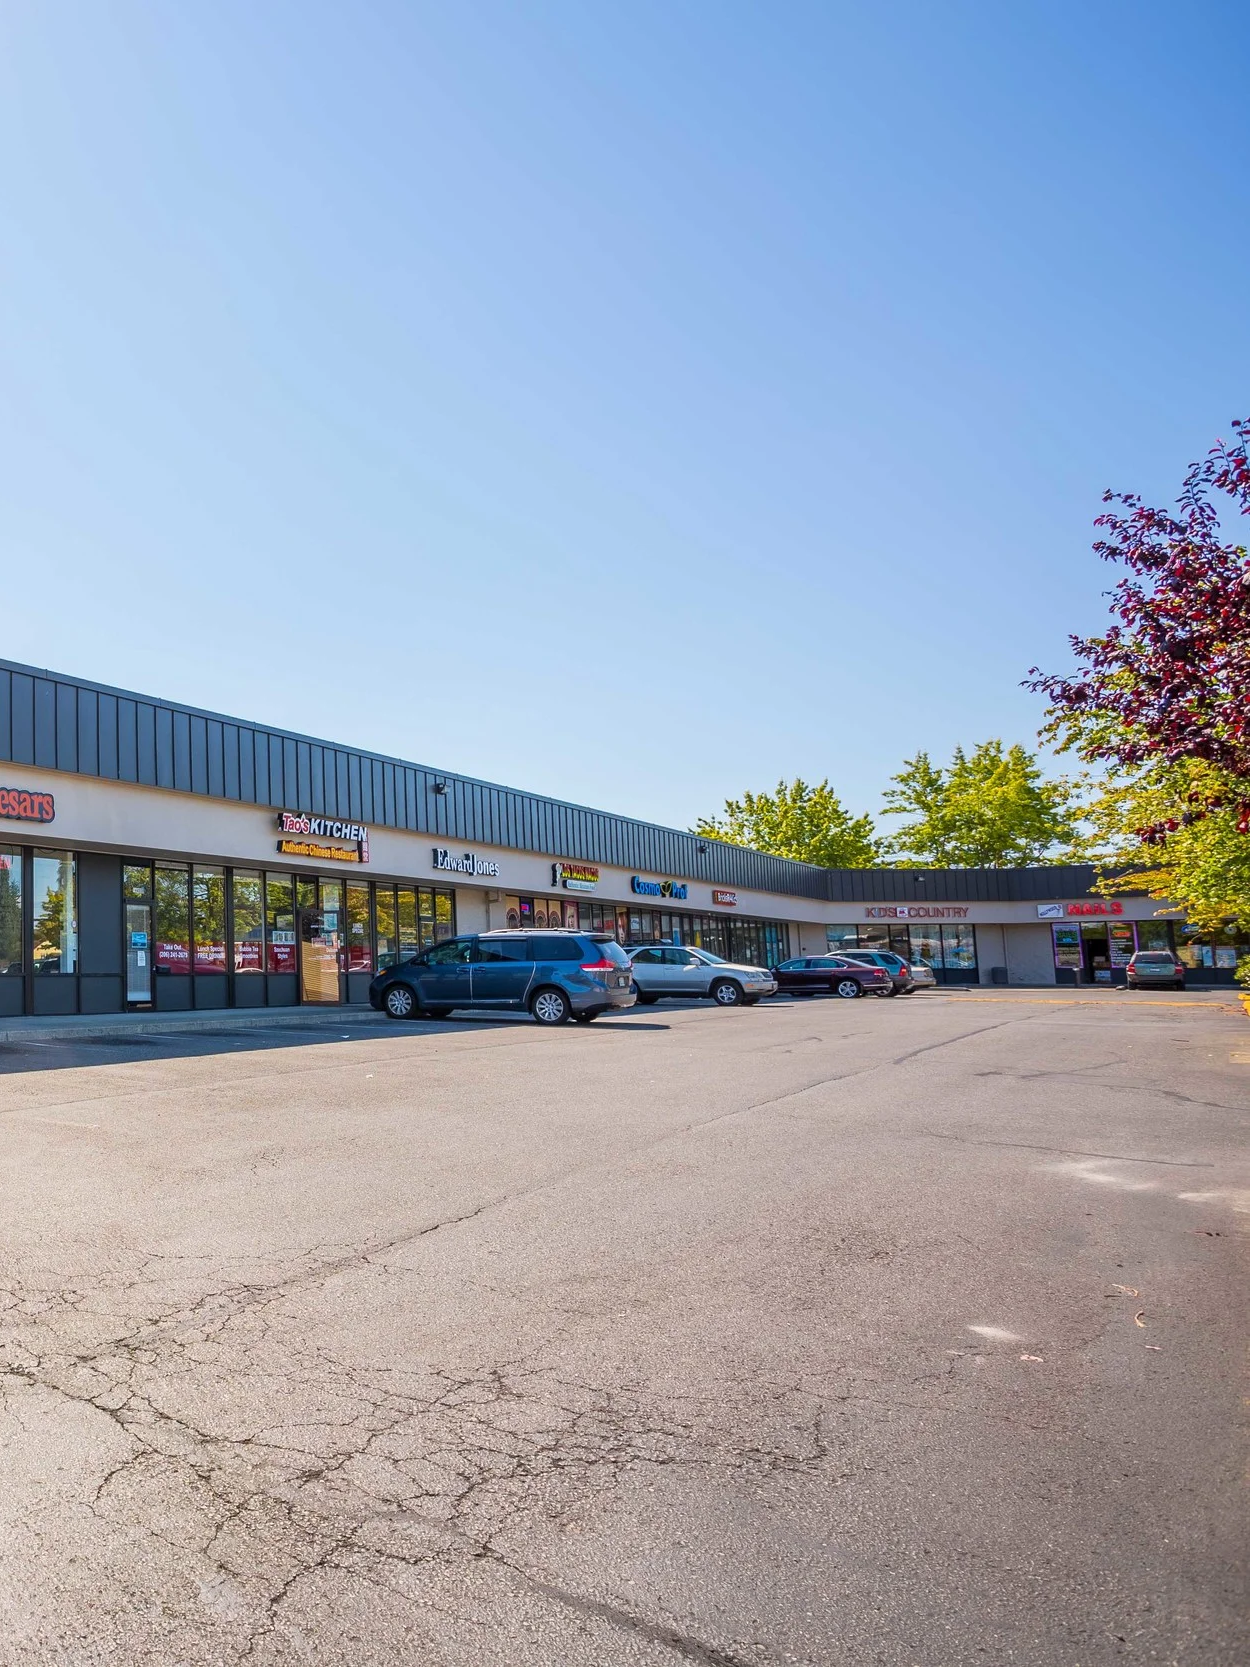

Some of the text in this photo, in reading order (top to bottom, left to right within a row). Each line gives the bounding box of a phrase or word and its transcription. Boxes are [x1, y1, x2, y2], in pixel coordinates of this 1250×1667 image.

[282, 812, 367, 841] Tao's KITCHEN
[282, 840, 309, 855] Authentic
[309, 844, 331, 858] Chinese
[331, 846, 359, 861] Restaurant
[634, 876, 688, 899] Cosmo Prof
[908, 906, 969, 918] COUNTRY
[1067, 901, 1124, 916] NAILS
